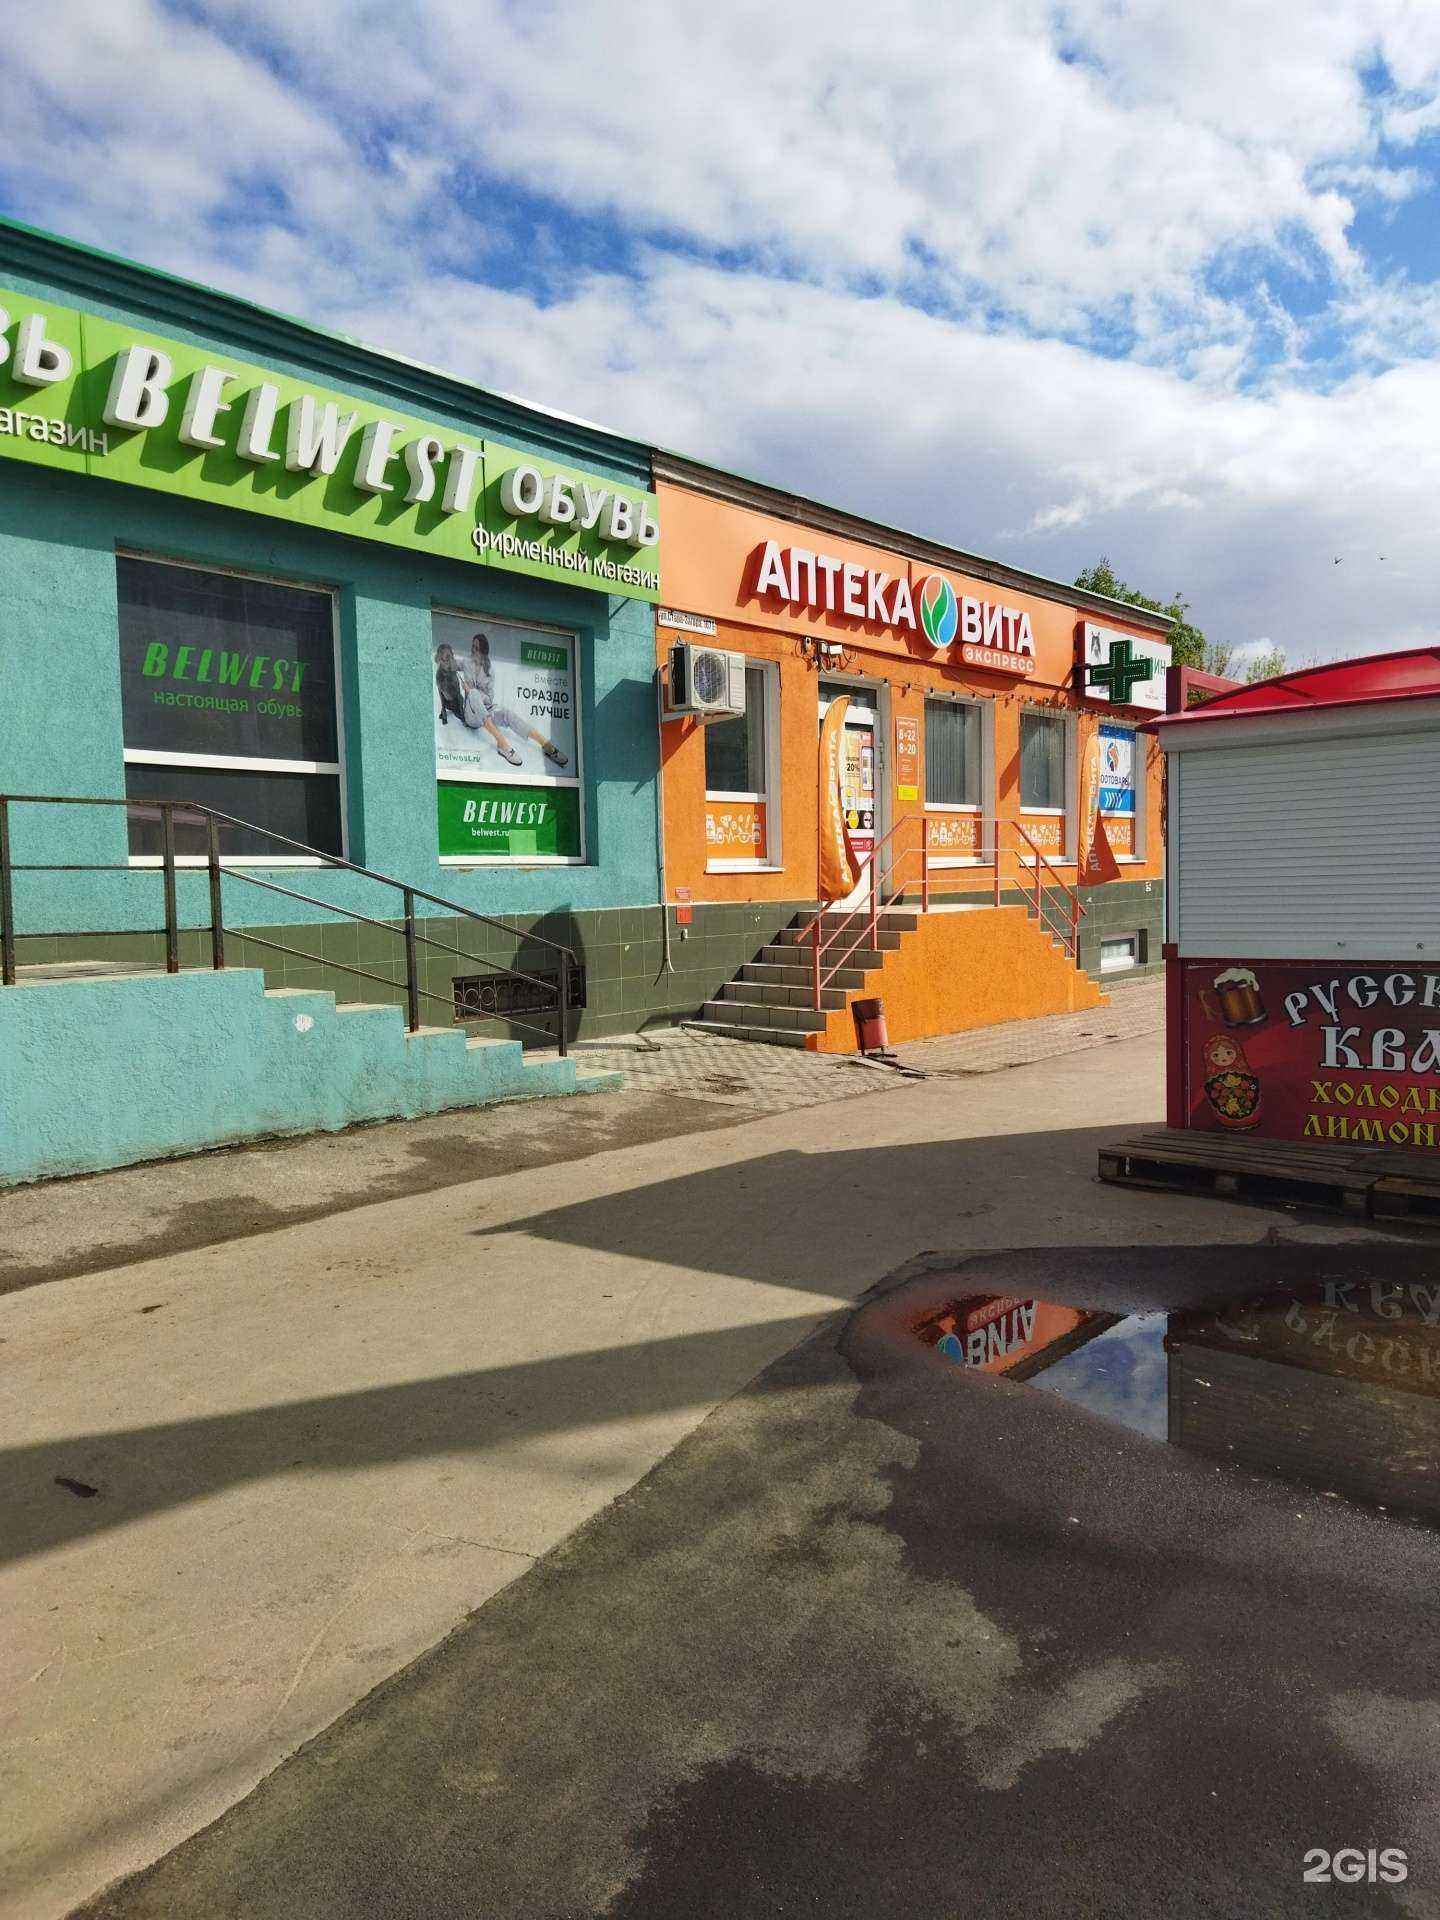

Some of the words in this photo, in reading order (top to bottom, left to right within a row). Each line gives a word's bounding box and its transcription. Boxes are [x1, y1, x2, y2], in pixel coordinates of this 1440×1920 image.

[0, 306, 73, 387] Ь
[103, 343, 486, 513] BELWEST
[500, 463, 661, 549] ОБУВЬ
[472, 521, 589, 573] фирменный
[593, 556, 662, 591] магазин
[756, 539, 918, 631] АПТЕКА
[961, 594, 1037, 657] ВИТА
[142, 642, 311, 693] BELWEST
[965, 647, 1036, 673] ЭКСПРЕСС
[153, 690, 249, 714] настоящая
[256, 698, 305, 719] обувь
[517, 686, 569, 704] ГОРАЗДО
[530, 705, 570, 719] ЛУЧШЕ
[463, 799, 549, 825] BELWEST
[471, 827, 510, 837] belwest.ru
[1303, 1114, 1440, 1147] ЛИМОН
